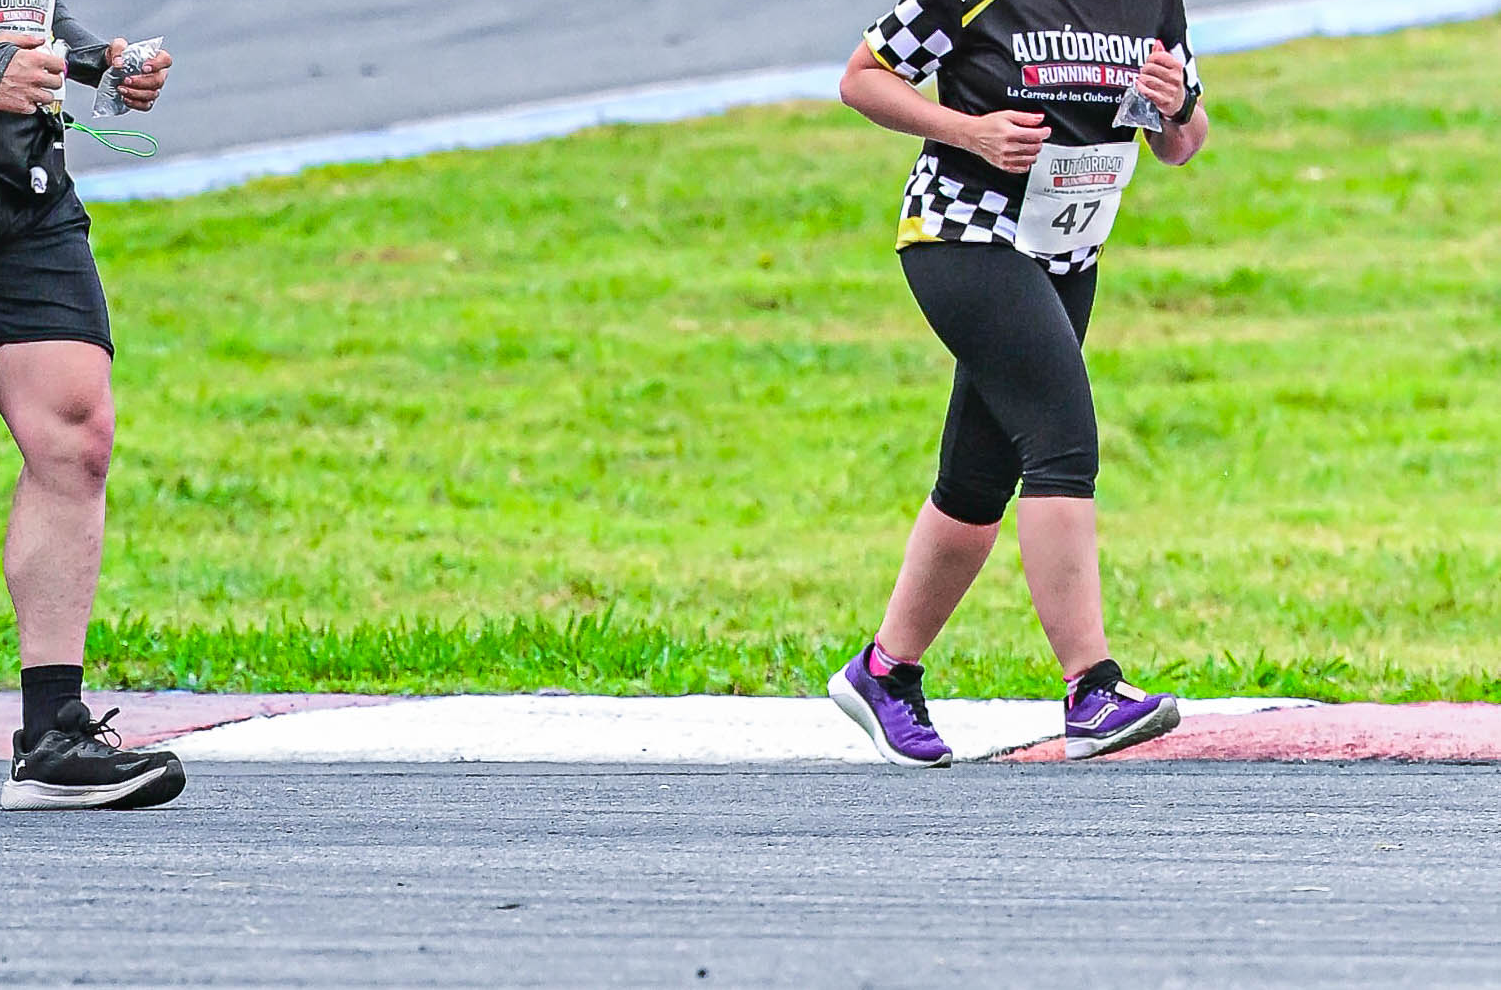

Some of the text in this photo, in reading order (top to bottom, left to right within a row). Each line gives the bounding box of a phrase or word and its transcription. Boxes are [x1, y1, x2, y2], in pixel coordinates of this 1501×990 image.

[1037, 65, 1102, 84] RUNNING
[1006, 86, 1019, 97] La
[1020, 88, 1054, 101] Carrera
[1056, 89, 1068, 101] de
[1068, 91, 1082, 102] los
[1083, 91, 1113, 104] Clubes
[1051, 199, 1101, 235] 47
